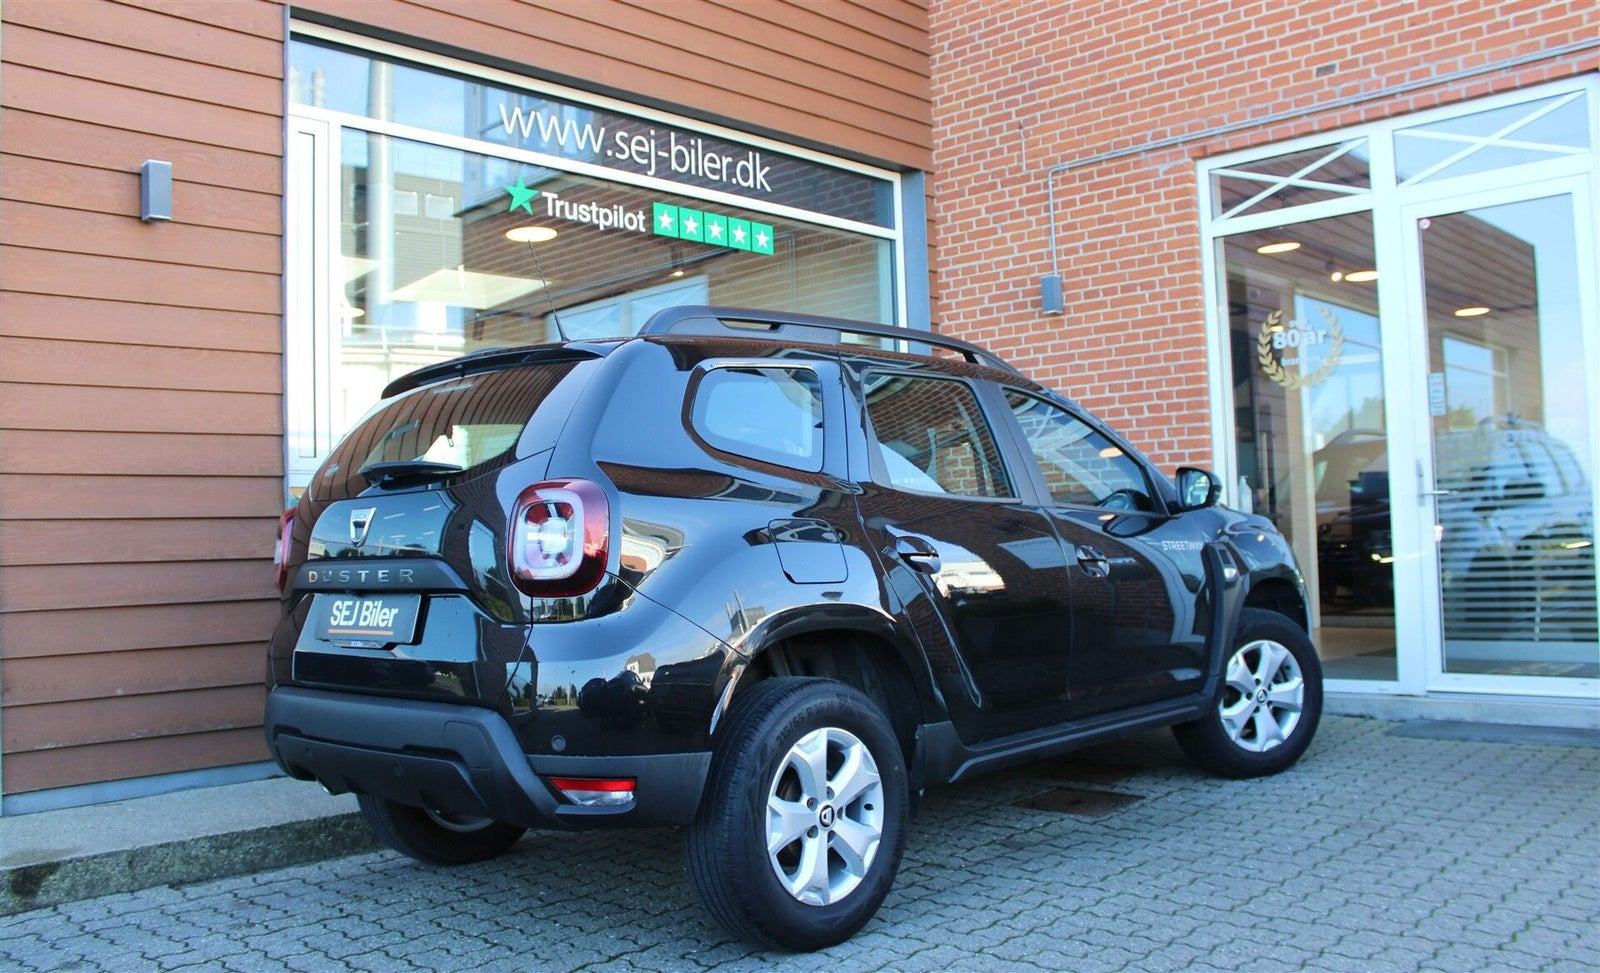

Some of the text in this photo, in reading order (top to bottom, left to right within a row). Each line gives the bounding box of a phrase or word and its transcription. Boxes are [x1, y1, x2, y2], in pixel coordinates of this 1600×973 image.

[499, 102, 772, 193] www.sej-biler.dk
[541, 190, 646, 232] Trustpilot
[1272, 329, 1300, 350] 80
[308, 568, 414, 583] DUSTER
[330, 600, 399, 628] SEJ Biler
